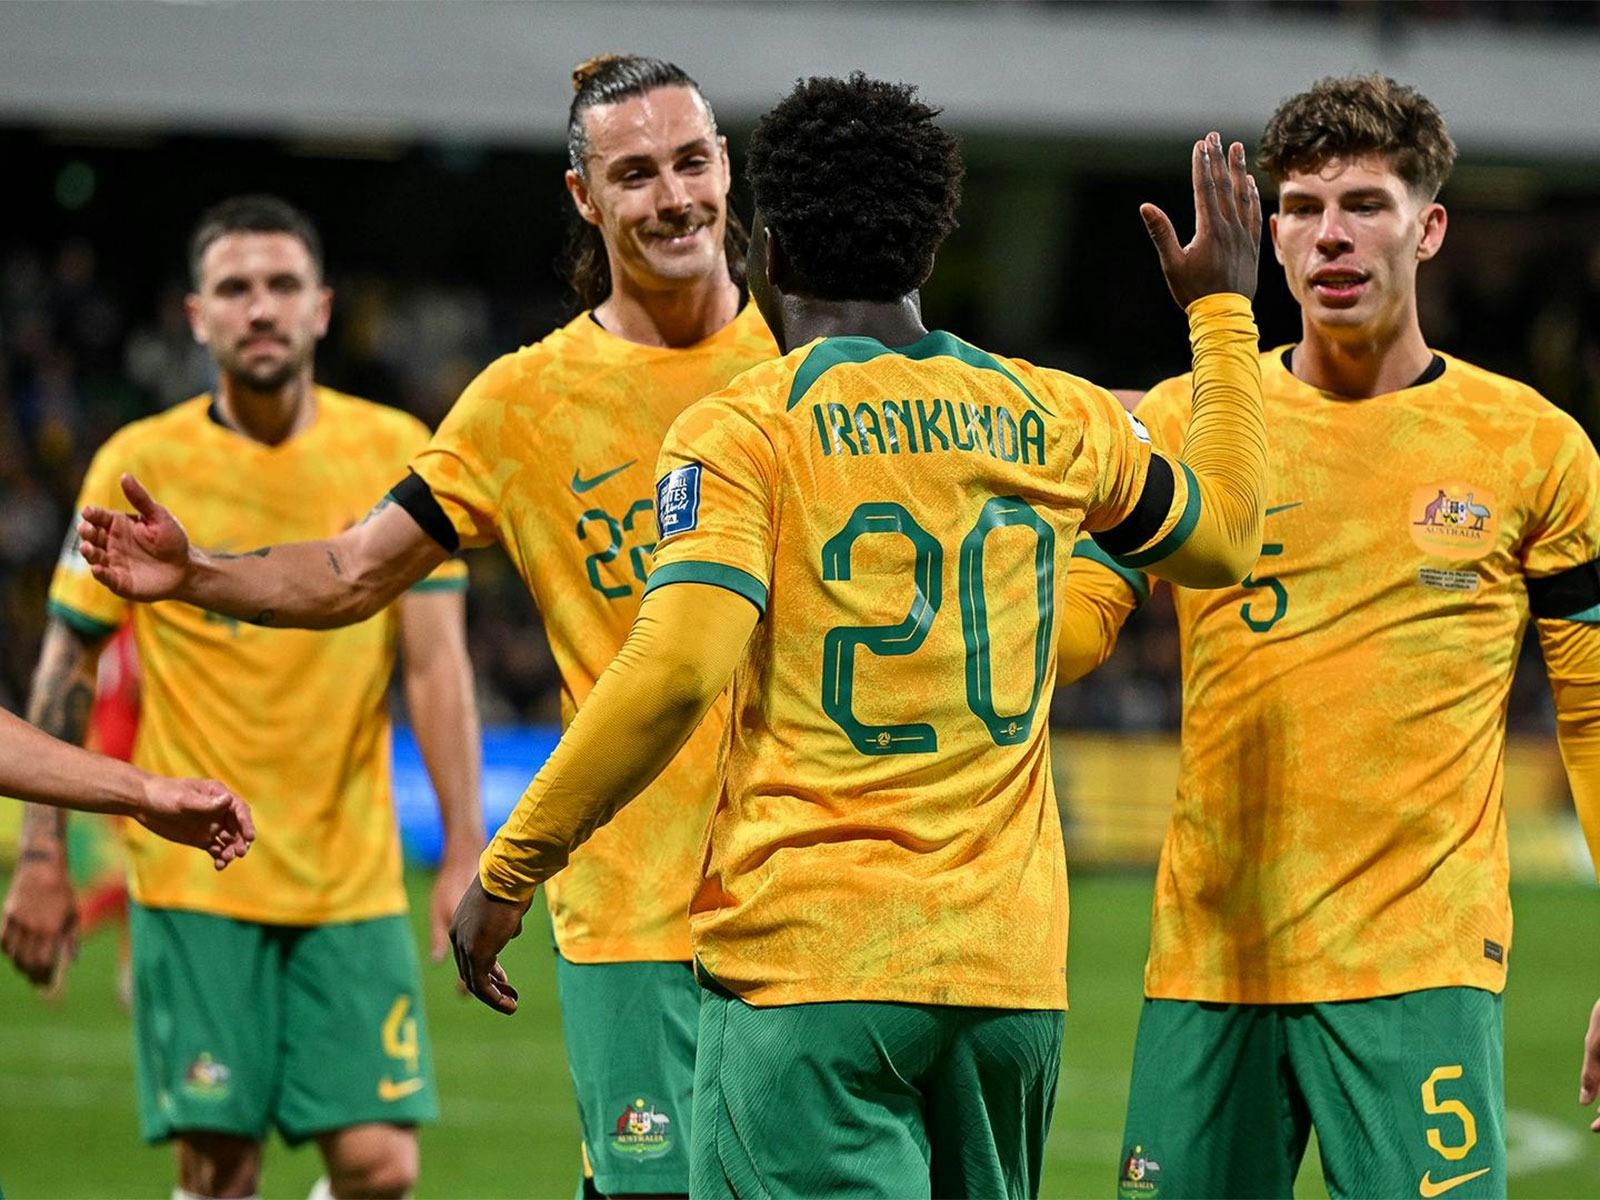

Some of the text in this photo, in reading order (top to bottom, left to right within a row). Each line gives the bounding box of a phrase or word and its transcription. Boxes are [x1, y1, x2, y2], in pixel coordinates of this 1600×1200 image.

[813, 399, 1046, 466] IRANKUNDA
[822, 495, 1056, 756] 20
[1240, 544, 1288, 633] 5
[383, 994, 418, 1074] 4
[1421, 1064, 1477, 1161] 5
